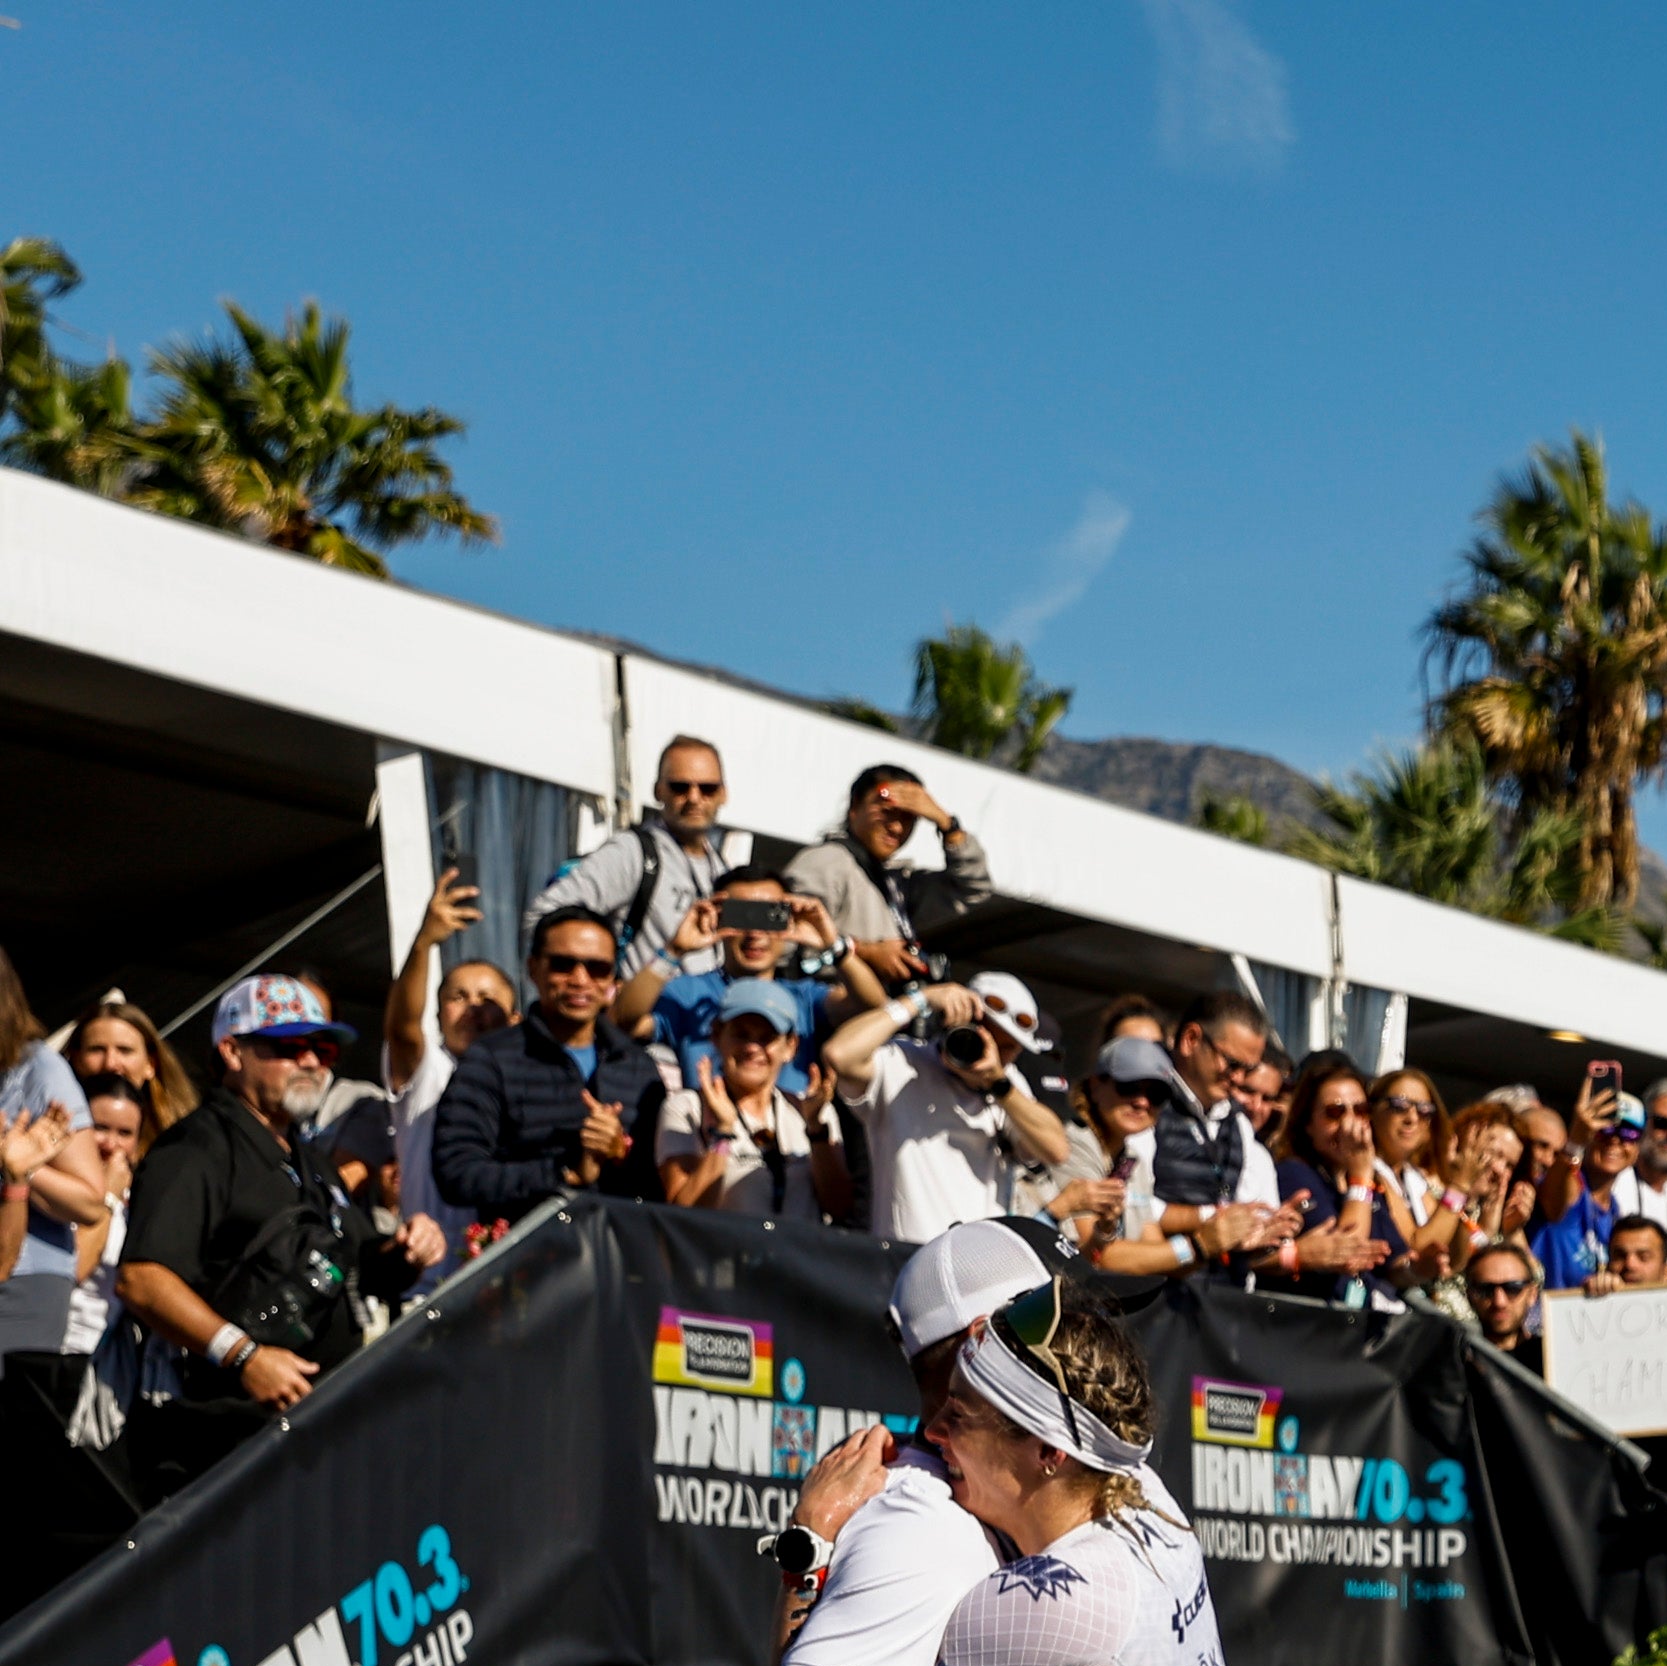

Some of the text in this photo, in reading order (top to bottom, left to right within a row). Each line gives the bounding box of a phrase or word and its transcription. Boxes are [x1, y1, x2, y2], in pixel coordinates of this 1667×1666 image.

[654, 1473, 764, 1530] WORLD
[1196, 1515, 1467, 1569] WORLD CHAMPIONSHIP
